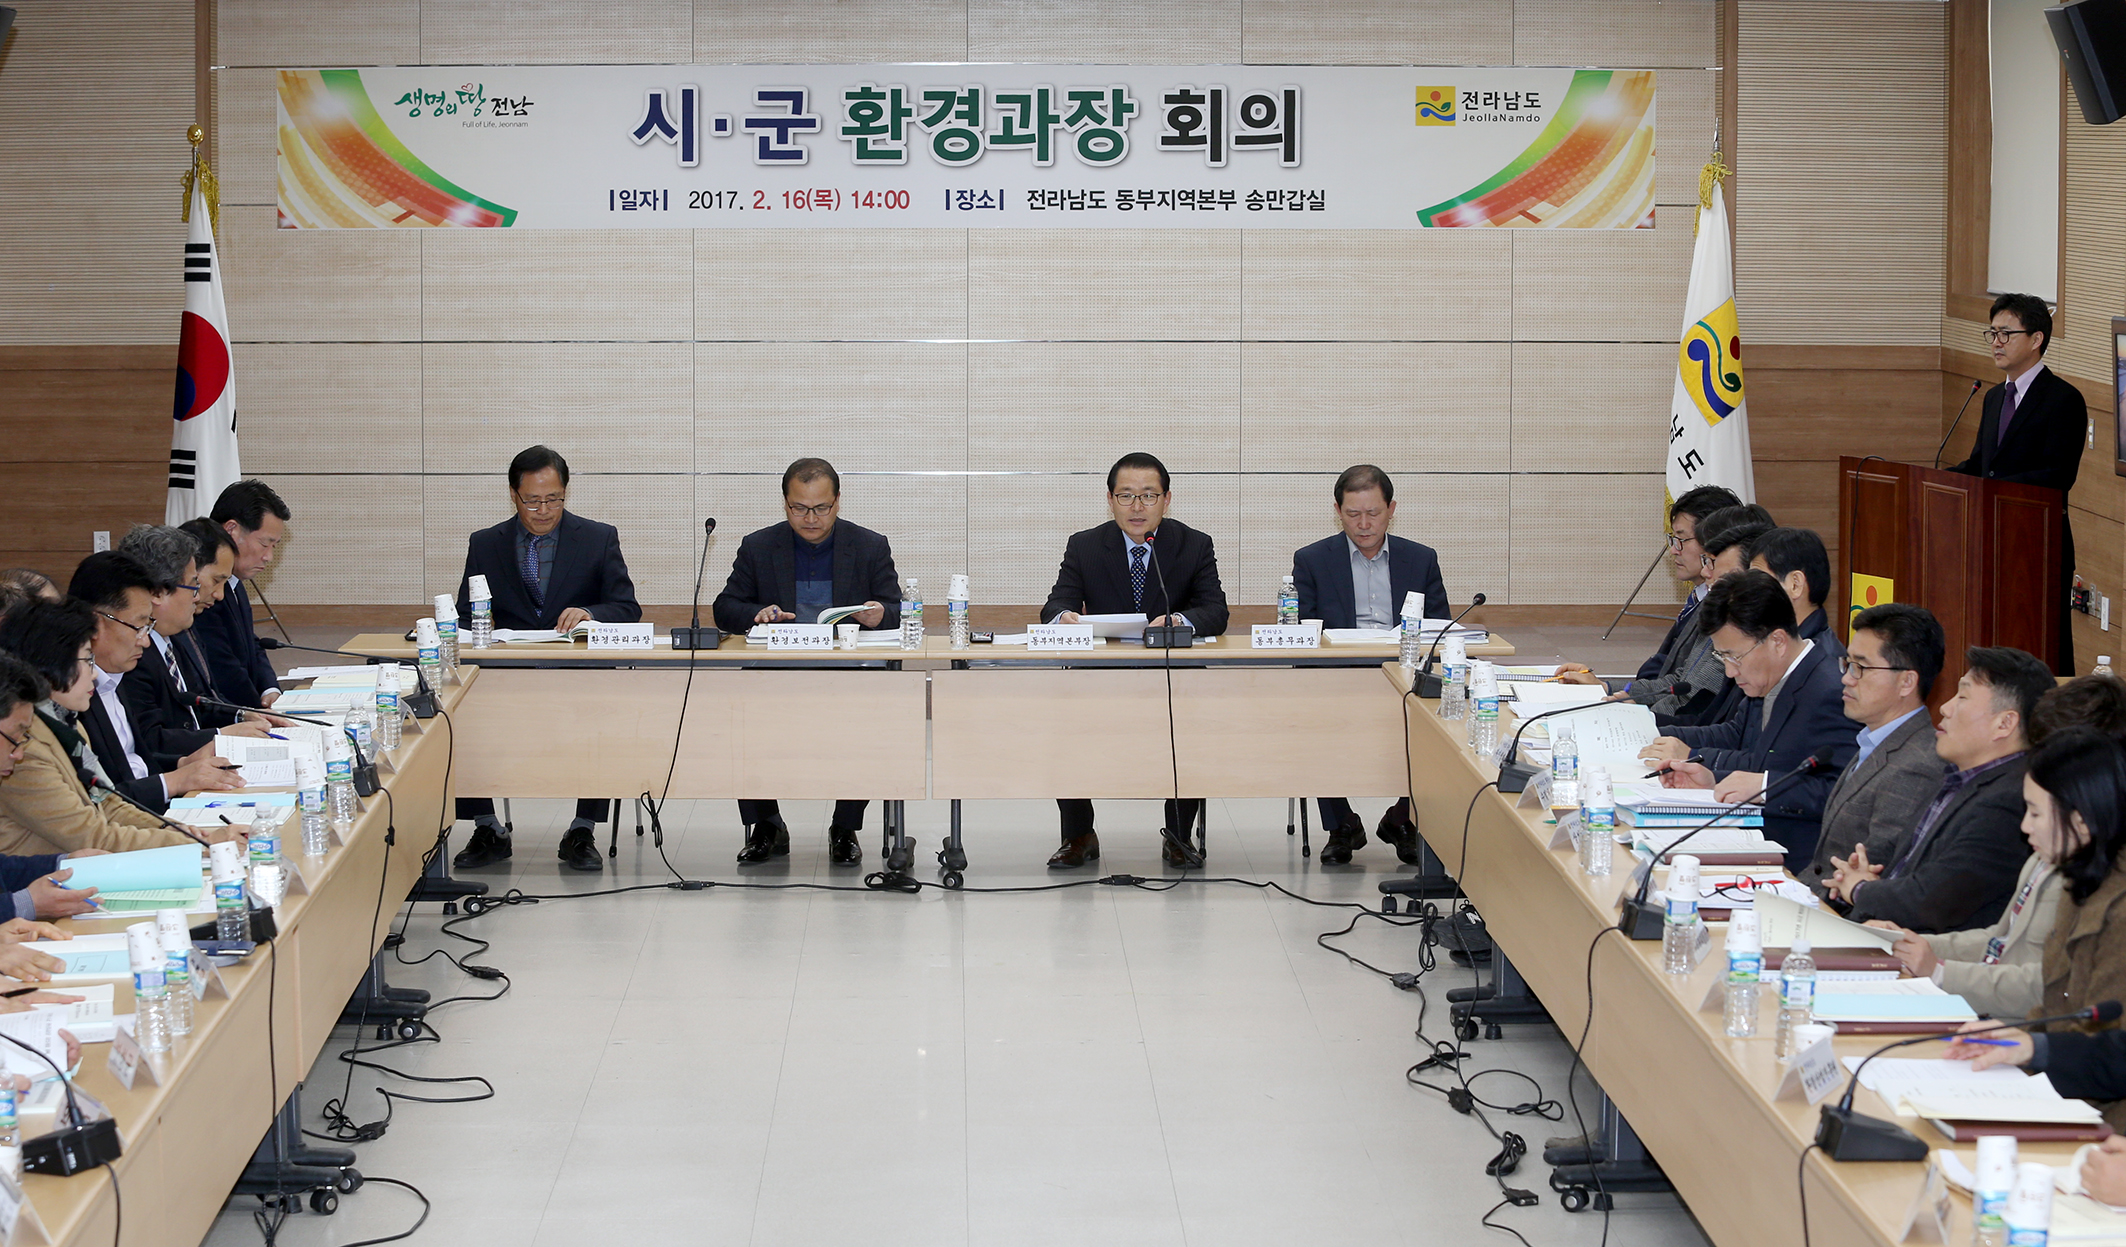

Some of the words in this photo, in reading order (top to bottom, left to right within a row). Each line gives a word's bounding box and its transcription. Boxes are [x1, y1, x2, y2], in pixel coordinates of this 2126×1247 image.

[394, 87, 458, 118] 생명의
[455, 83, 487, 118] 땅
[490, 95, 535, 117] 전남
[1461, 91, 1542, 111] 전라남도
[483, 121, 498, 129] Life,
[840, 85, 1135, 163] 환경과장
[1159, 87, 1297, 163] 회의
[1462, 113, 1541, 122] JeollaNamdo
[688, 190, 744, 211] 2017.
[752, 189, 772, 211] 2.
[782, 187, 841, 212] 16(목)
[851, 189, 910, 210] 14:00
[1026, 189, 1107, 211] 전라남도
[1115, 188, 1237, 211] 동부지역본부
[1244, 188, 1326, 211] 송만갑실
[591, 634, 651, 645] 환경관리과장
[770, 635, 831, 646] 환경보전과장
[1030, 636, 1091, 646] 동부지역본부장
